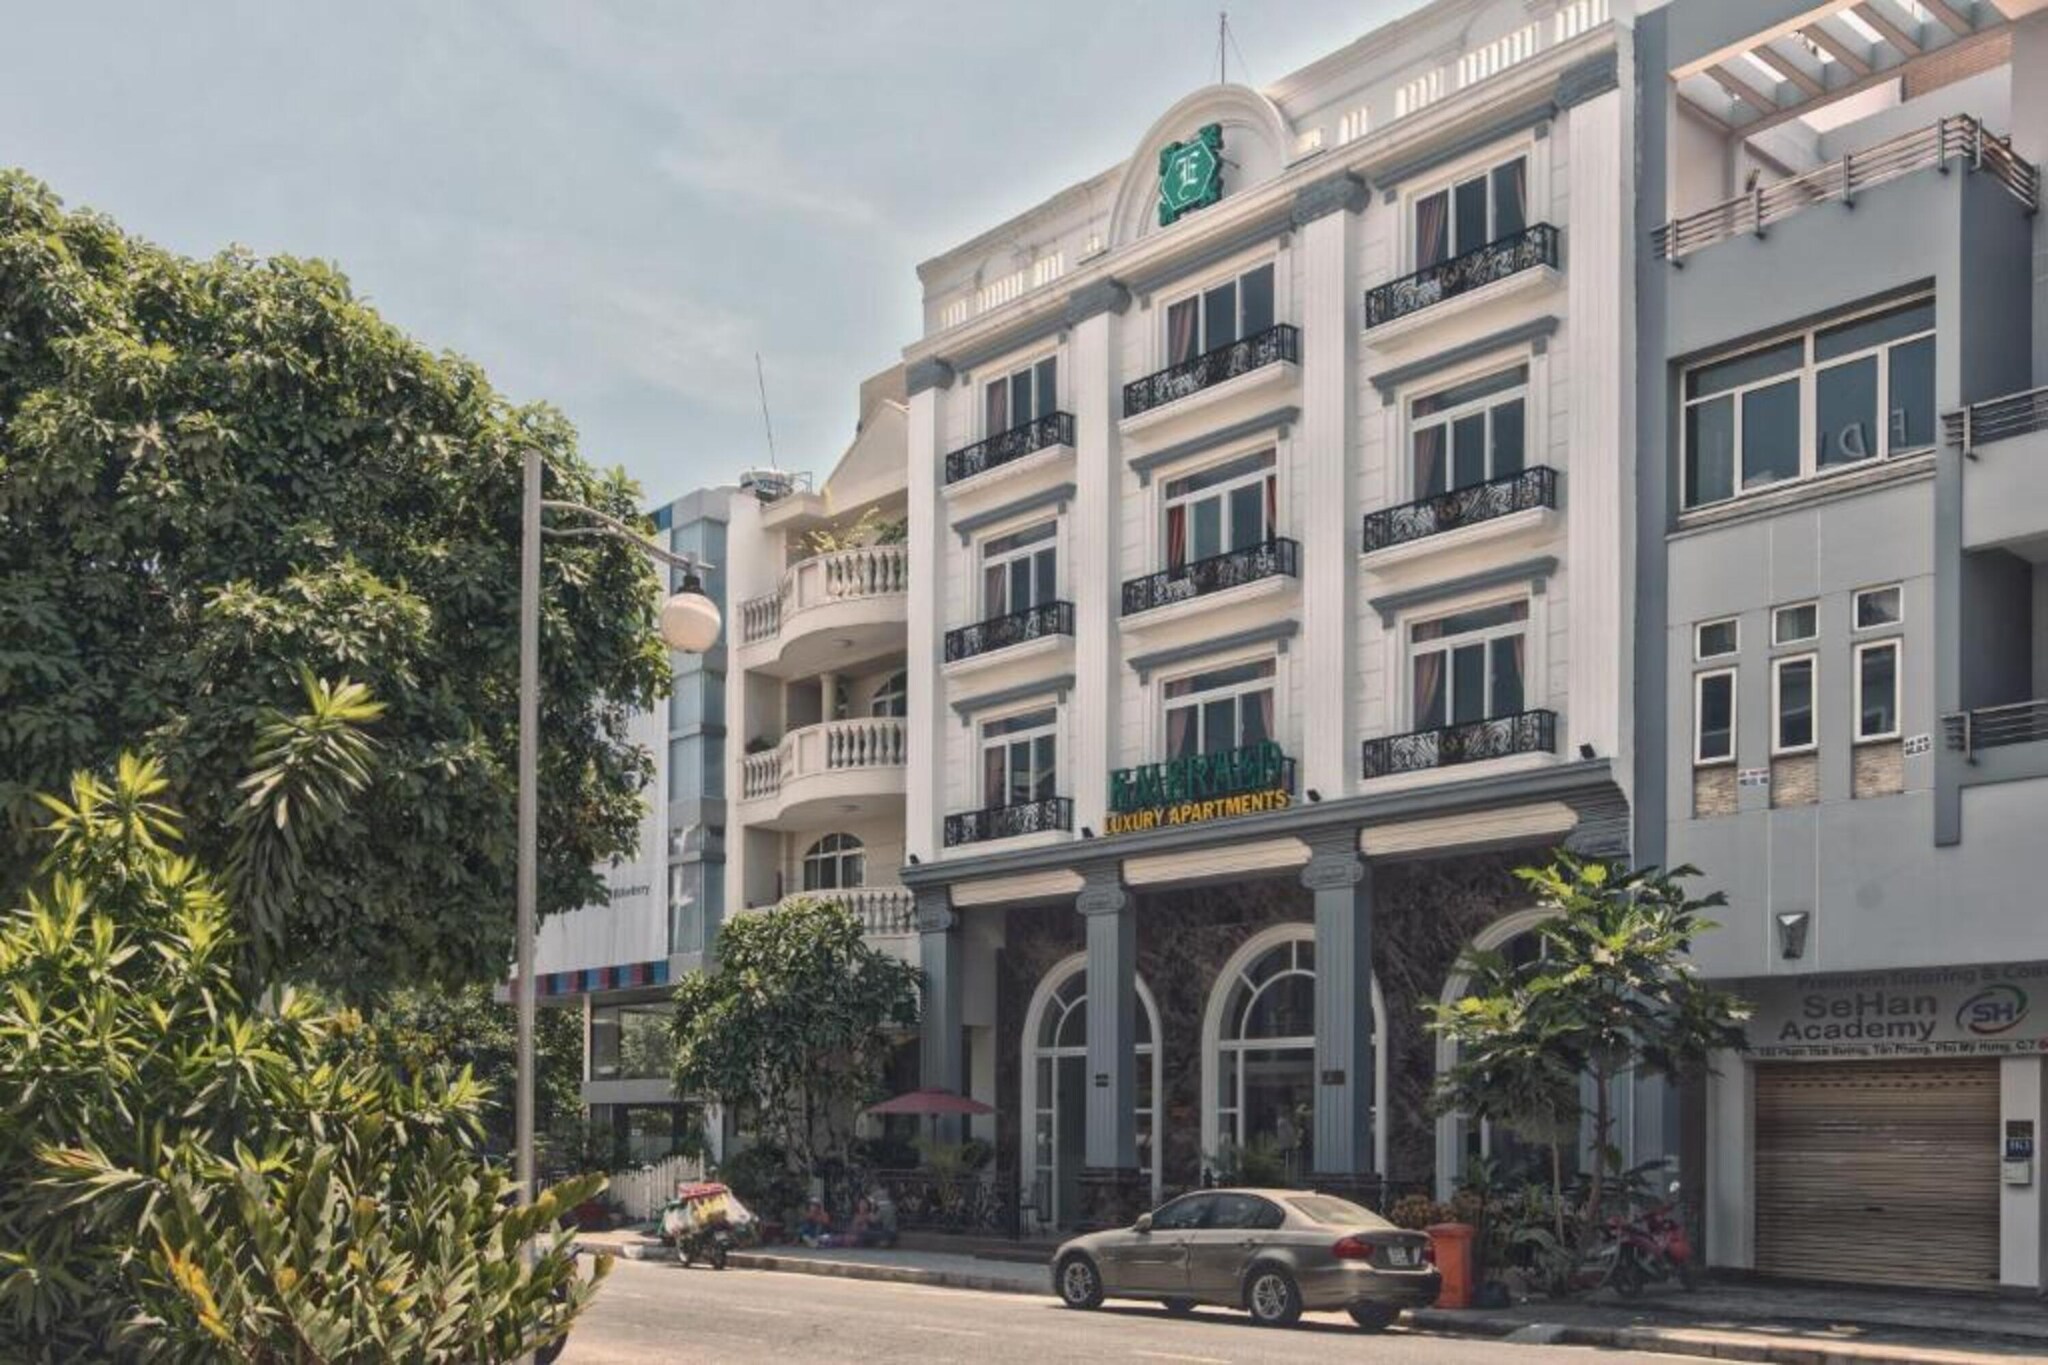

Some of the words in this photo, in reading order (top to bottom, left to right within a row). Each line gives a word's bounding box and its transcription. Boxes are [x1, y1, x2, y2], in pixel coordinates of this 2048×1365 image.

[1176, 151, 1201, 200] E
[1104, 809, 1166, 835] LUXURY
[1168, 788, 1290, 825] APARTMENTS
[1891, 967, 1976, 987] Tutoring
[1802, 991, 1938, 1019] SeHan
[1970, 1002, 2015, 1023] SH
[1778, 1018, 1938, 1042] Academy
